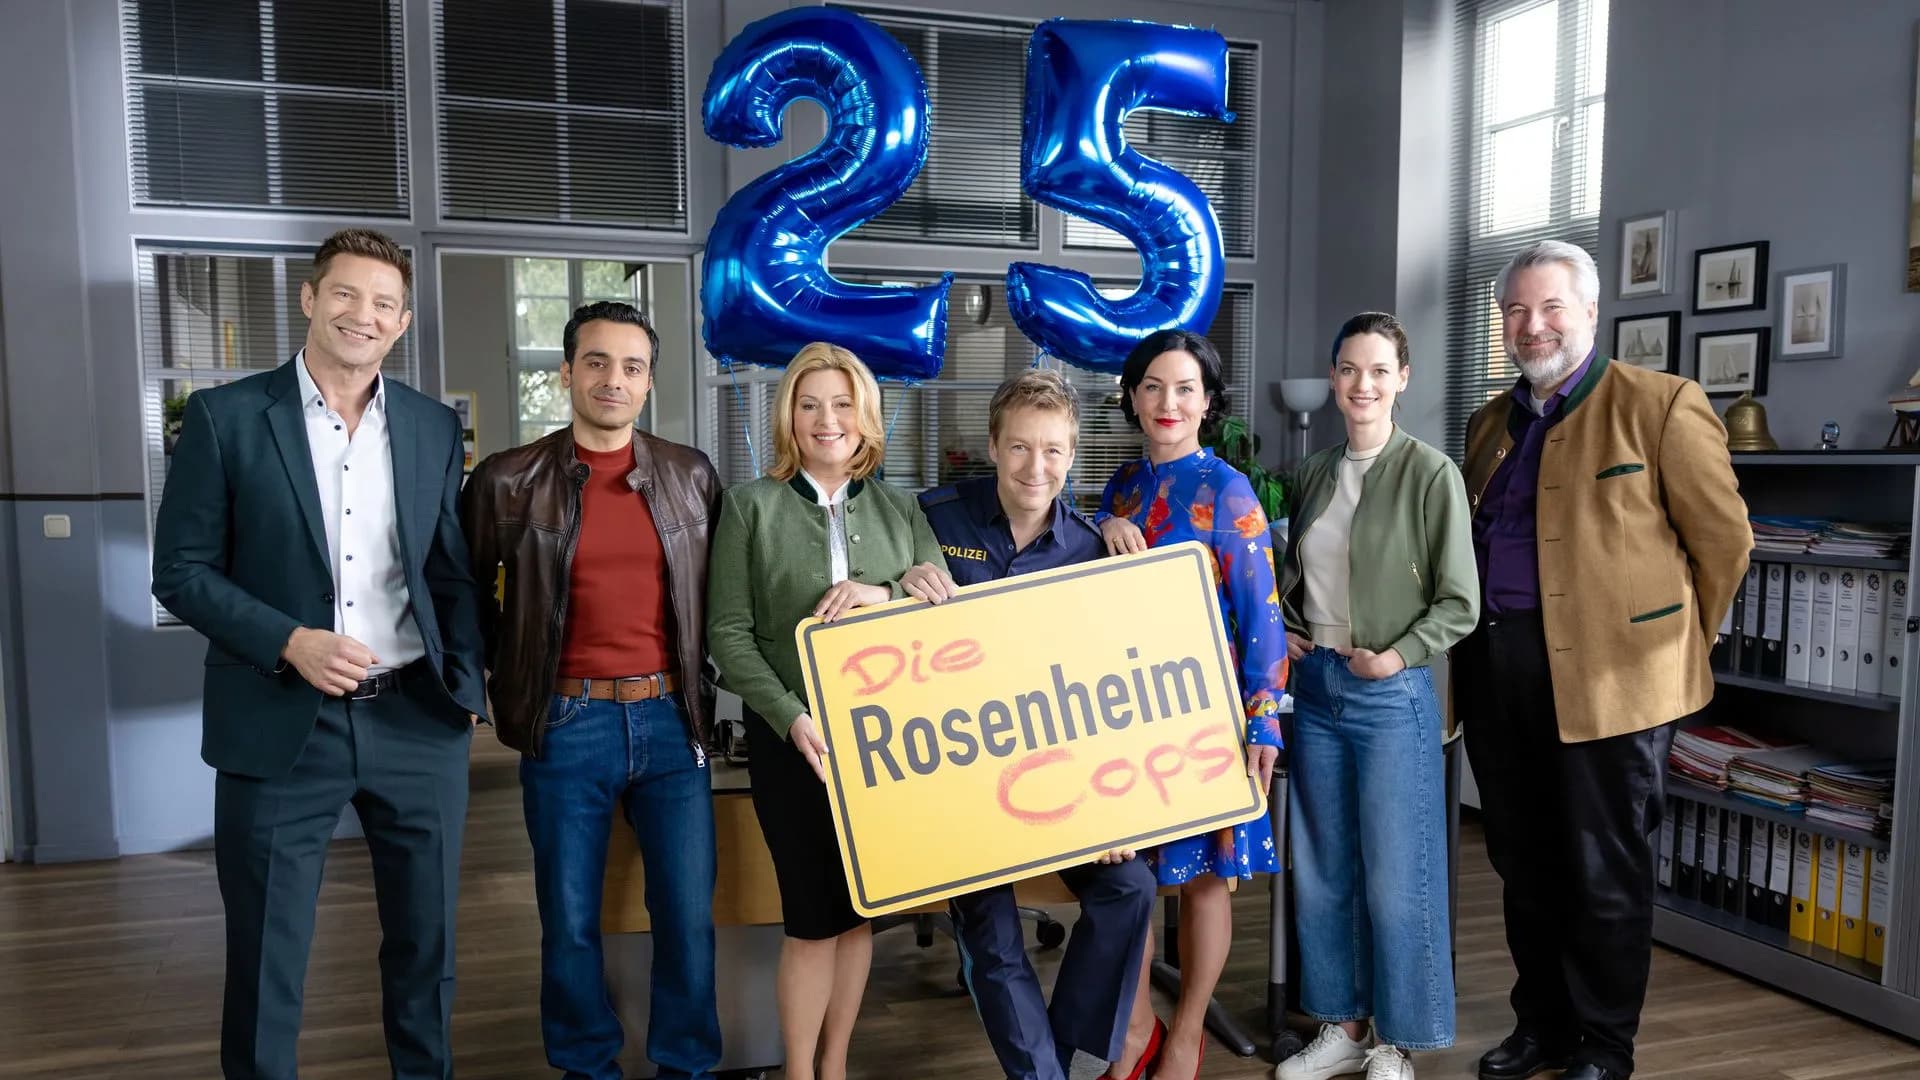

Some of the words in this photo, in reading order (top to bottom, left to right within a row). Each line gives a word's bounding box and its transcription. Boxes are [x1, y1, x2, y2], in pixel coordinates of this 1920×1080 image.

[701, 6, 1235, 377] 25
[941, 544, 987, 561] POLIZEI
[840, 638, 986, 697] Die
[850, 647, 1211, 788] Rosenheim
[996, 723, 1235, 826] Cops
